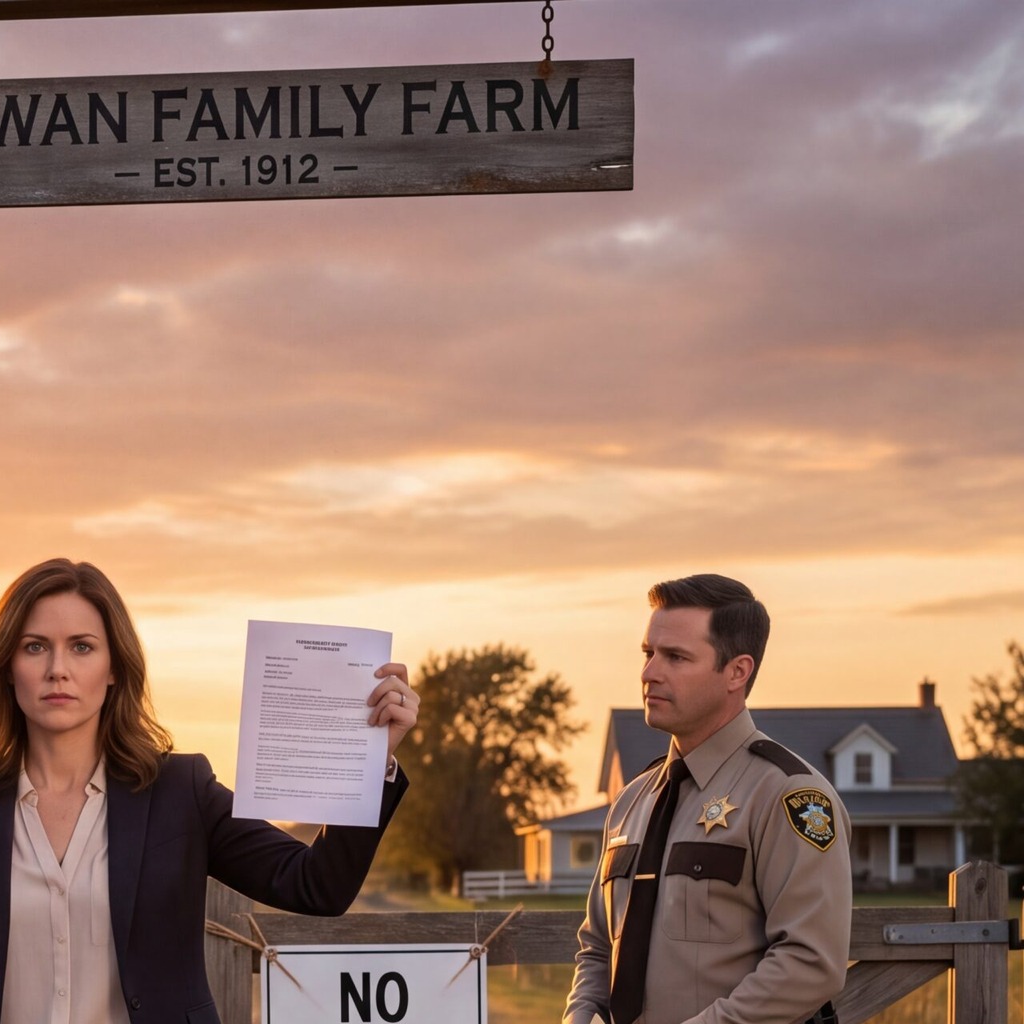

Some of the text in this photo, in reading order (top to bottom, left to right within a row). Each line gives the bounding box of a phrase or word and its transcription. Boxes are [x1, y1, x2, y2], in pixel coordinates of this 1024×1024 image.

[152, 82, 380, 142] FAMILY
[402, 77, 581, 135] FARM
[154, 154, 320, 188] EST. 1912
[340, 971, 409, 1023] NO
